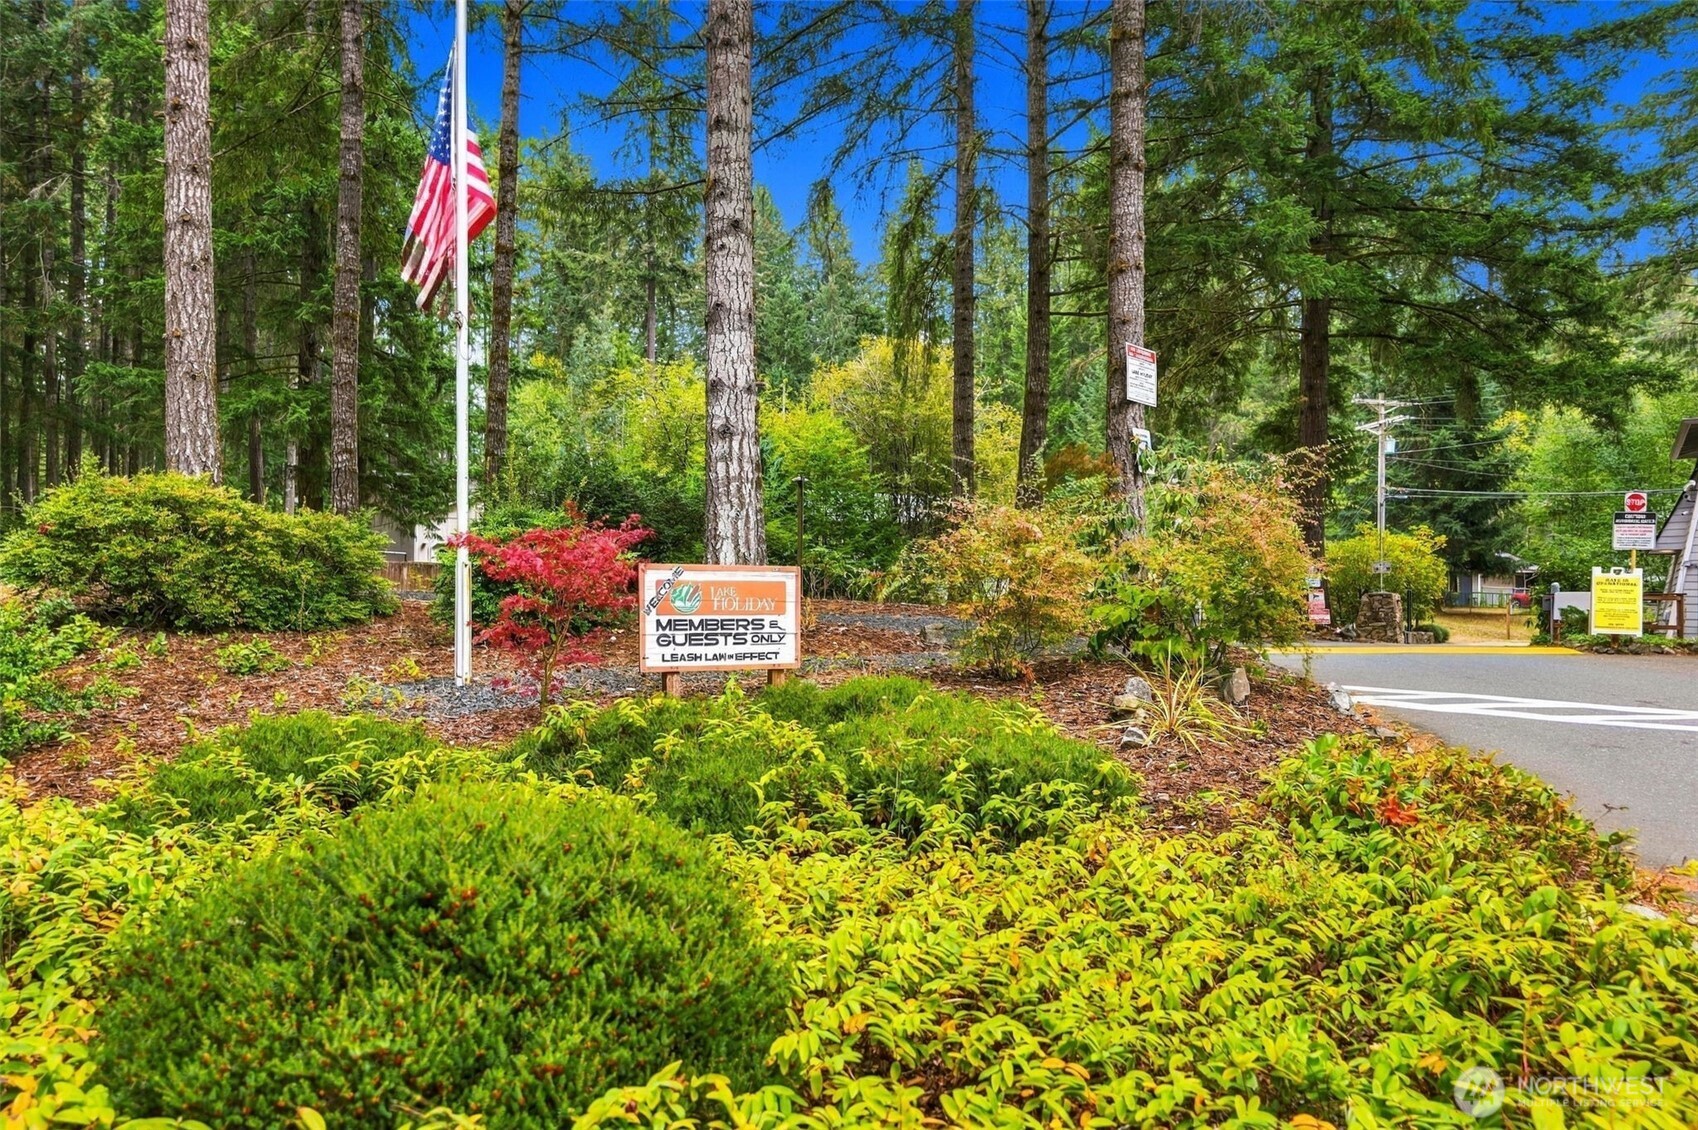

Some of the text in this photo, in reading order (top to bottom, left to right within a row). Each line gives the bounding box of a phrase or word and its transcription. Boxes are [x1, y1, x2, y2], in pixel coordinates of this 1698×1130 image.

[1626, 498, 1646, 506] STOP
[643, 566, 684, 616] WELCOME
[710, 586, 737, 600] LAKE
[713, 597, 778, 611] HOLIDAY
[655, 618, 765, 632] MEMBERS
[656, 632, 786, 647] GUESTS ONLY
[661, 653, 702, 663] LEASH
[704, 652, 727, 662] LAW
[734, 651, 780, 661] EFFECT
